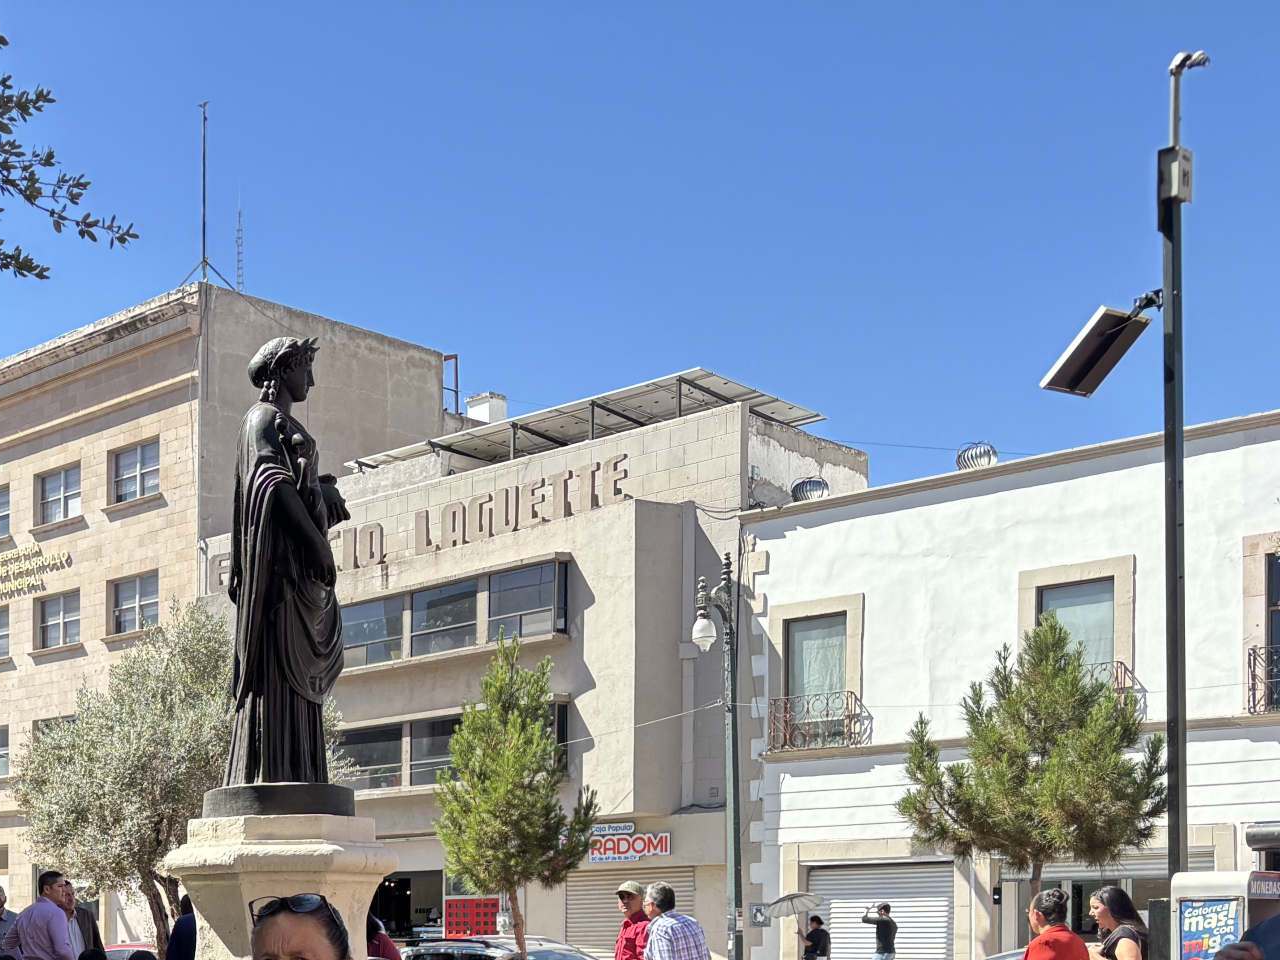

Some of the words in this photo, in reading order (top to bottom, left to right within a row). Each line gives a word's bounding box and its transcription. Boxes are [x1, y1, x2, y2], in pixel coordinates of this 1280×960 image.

[415, 453, 631, 555] LAGUETTE
[8, 550, 69, 575] DESARROLLO
[608, 824, 633, 833] Popular
[1184, 903, 1230, 918] Cotorrea
[1213, 925, 1235, 935] con
